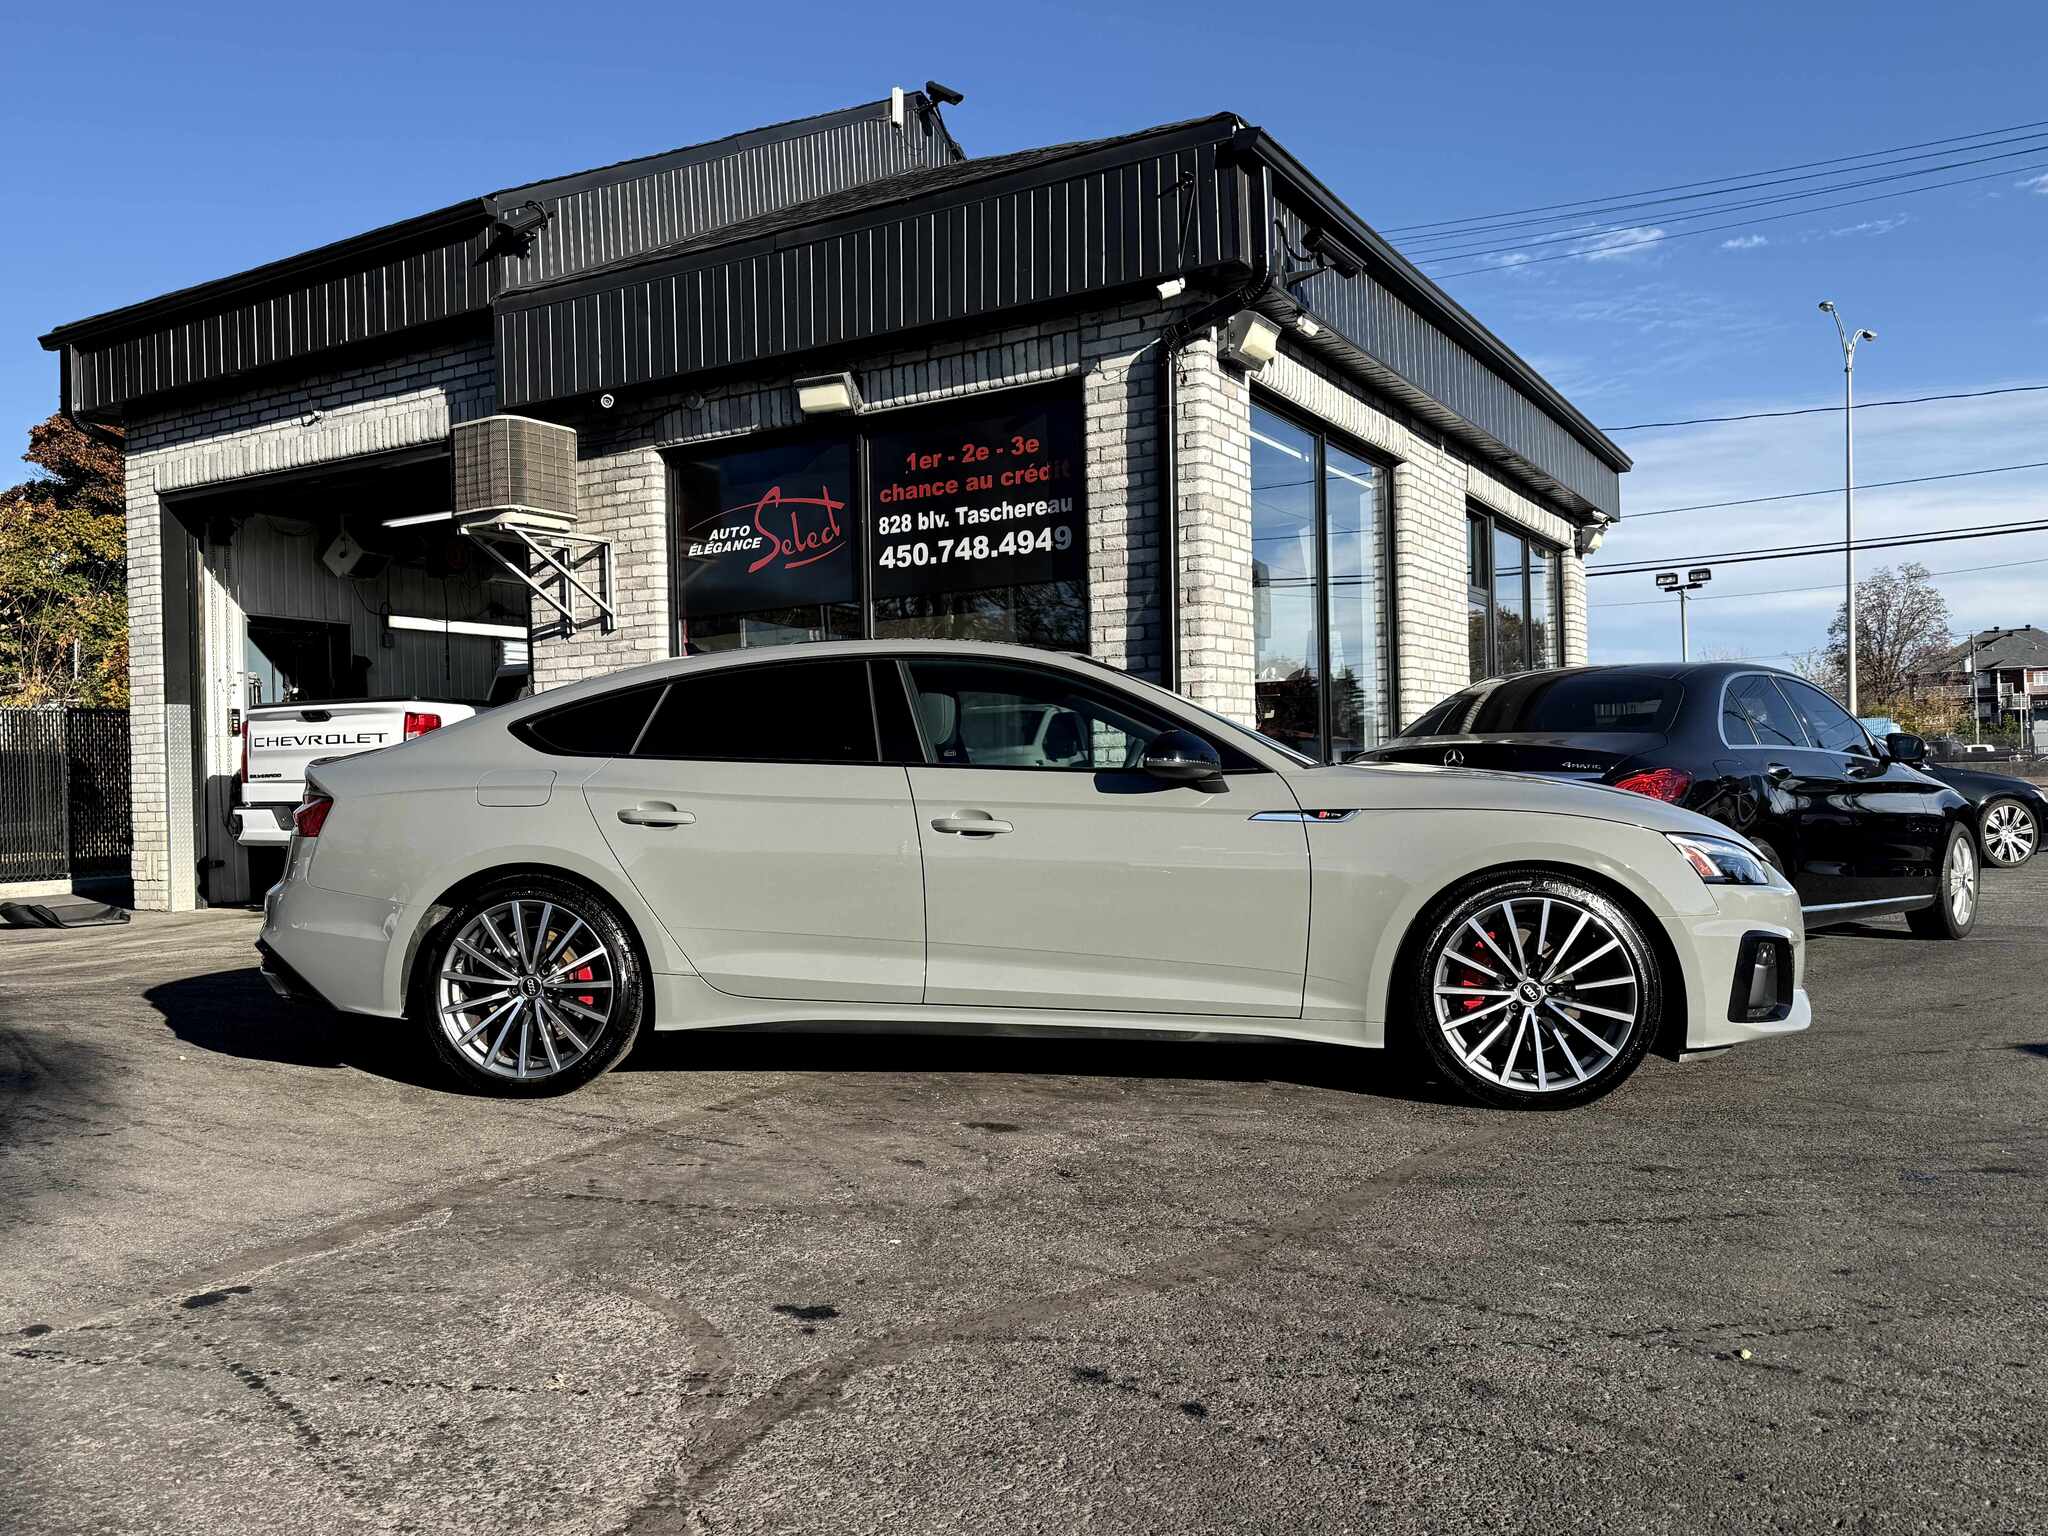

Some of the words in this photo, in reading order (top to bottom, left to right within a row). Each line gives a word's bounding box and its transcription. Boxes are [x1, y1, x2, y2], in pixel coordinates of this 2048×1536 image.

[907, 452, 942, 471] 1er
[962, 444, 989, 463] 2e
[1011, 436, 1040, 455] 3e
[880, 479, 959, 503] chance
[966, 474, 993, 492] au
[747, 485, 845, 573] Select
[879, 514, 912, 534] 828
[917, 510, 950, 530] blv.
[955, 497, 1072, 526] Taschereau
[688, 537, 762, 556] ÉLÉGANCE
[709, 525, 750, 540] AUTO
[879, 525, 1072, 569] 450.748.4949
[254, 732, 388, 748] CHEVROLET
